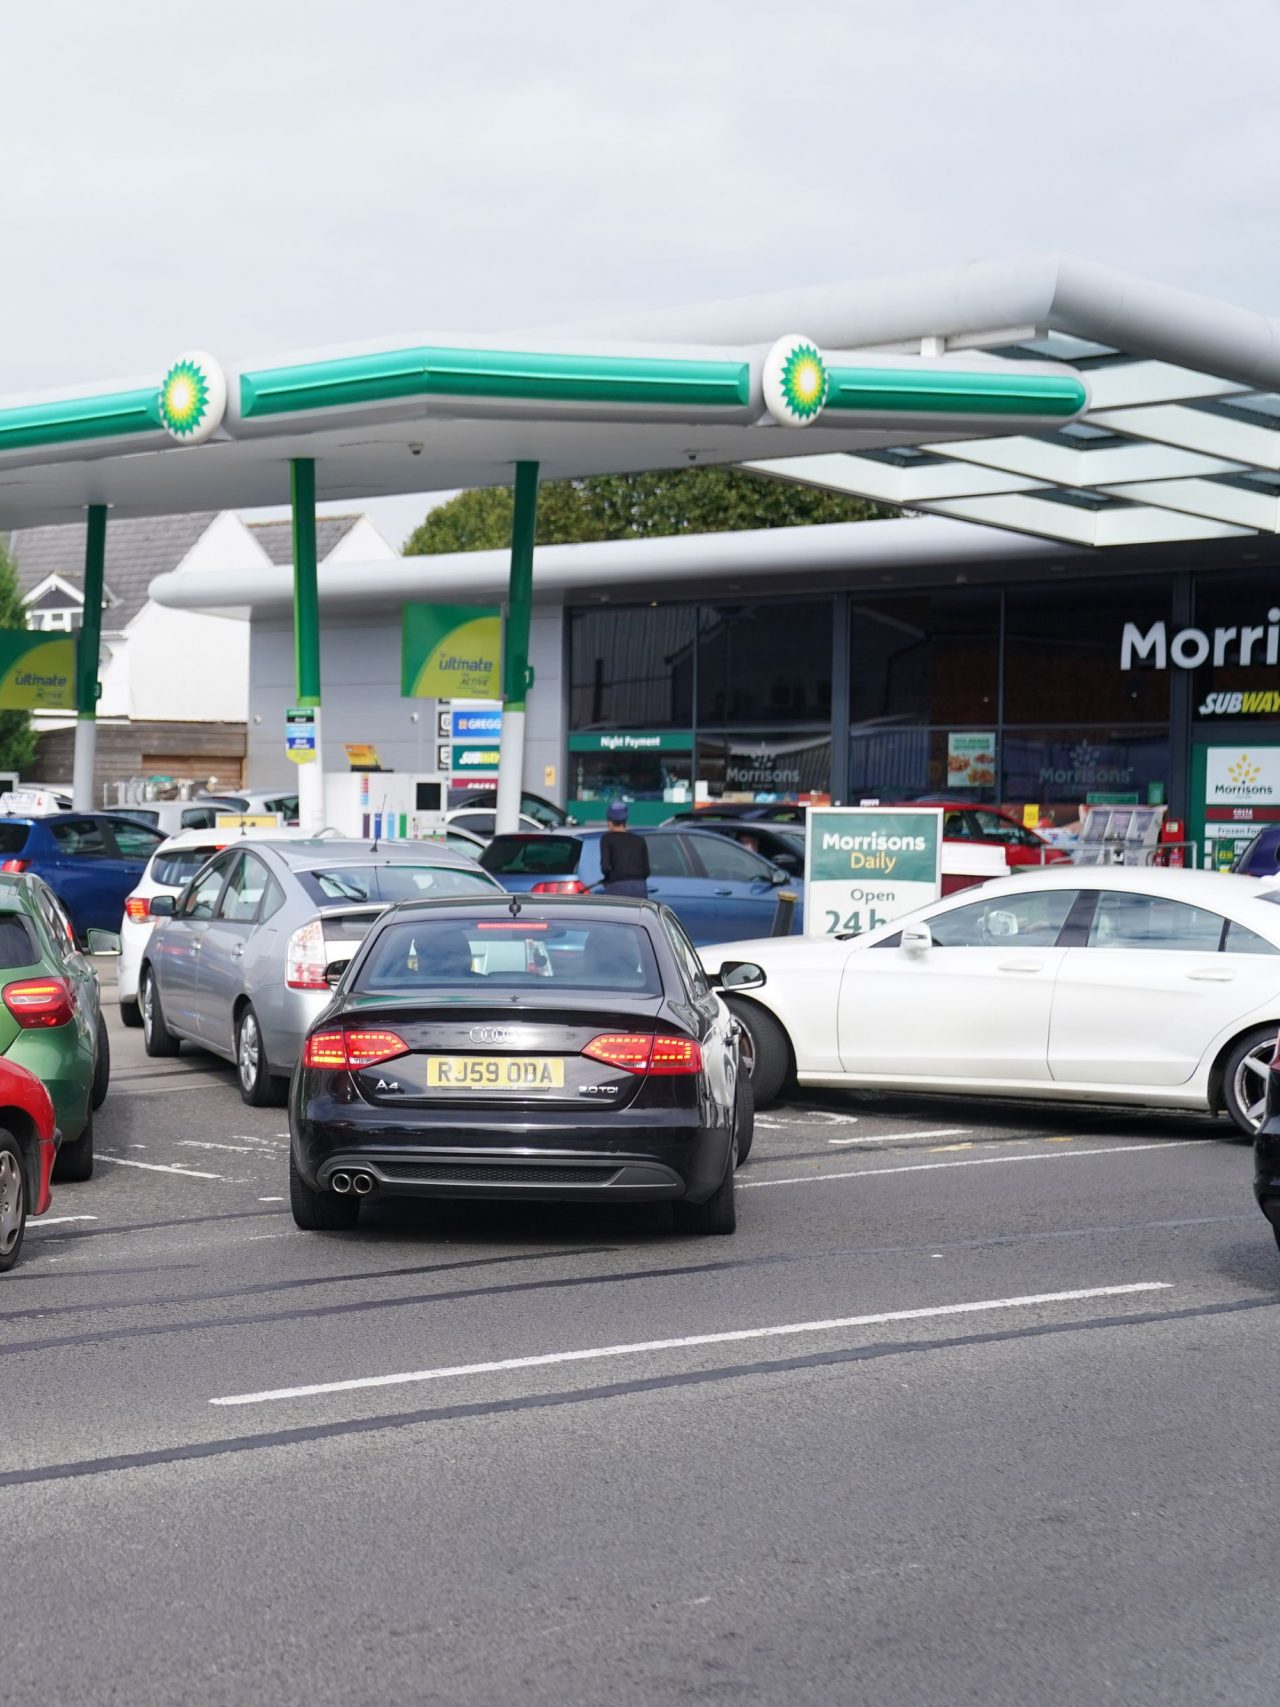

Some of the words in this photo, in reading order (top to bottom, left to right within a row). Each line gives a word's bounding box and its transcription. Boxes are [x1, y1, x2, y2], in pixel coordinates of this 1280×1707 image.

[1120, 606, 1280, 671] Morri
[438, 655, 493, 672] ultimate
[15, 672, 67, 687] ultimate
[460, 678, 489, 687] ACTIVE
[468, 719, 501, 730] GREGG
[600, 736, 623, 749] Night
[625, 736, 661, 749] Payment
[726, 767, 799, 784] Morrisons
[1039, 767, 1130, 784] Morrisons
[1215, 780, 1273, 795] Morrisons
[822, 831, 926, 851] Morrisons
[850, 852, 897, 874] Daily
[850, 888, 895, 904] Open
[825, 909, 862, 935] 24
[438, 1061, 500, 1083] RJ59
[375, 1079, 399, 1090] A4
